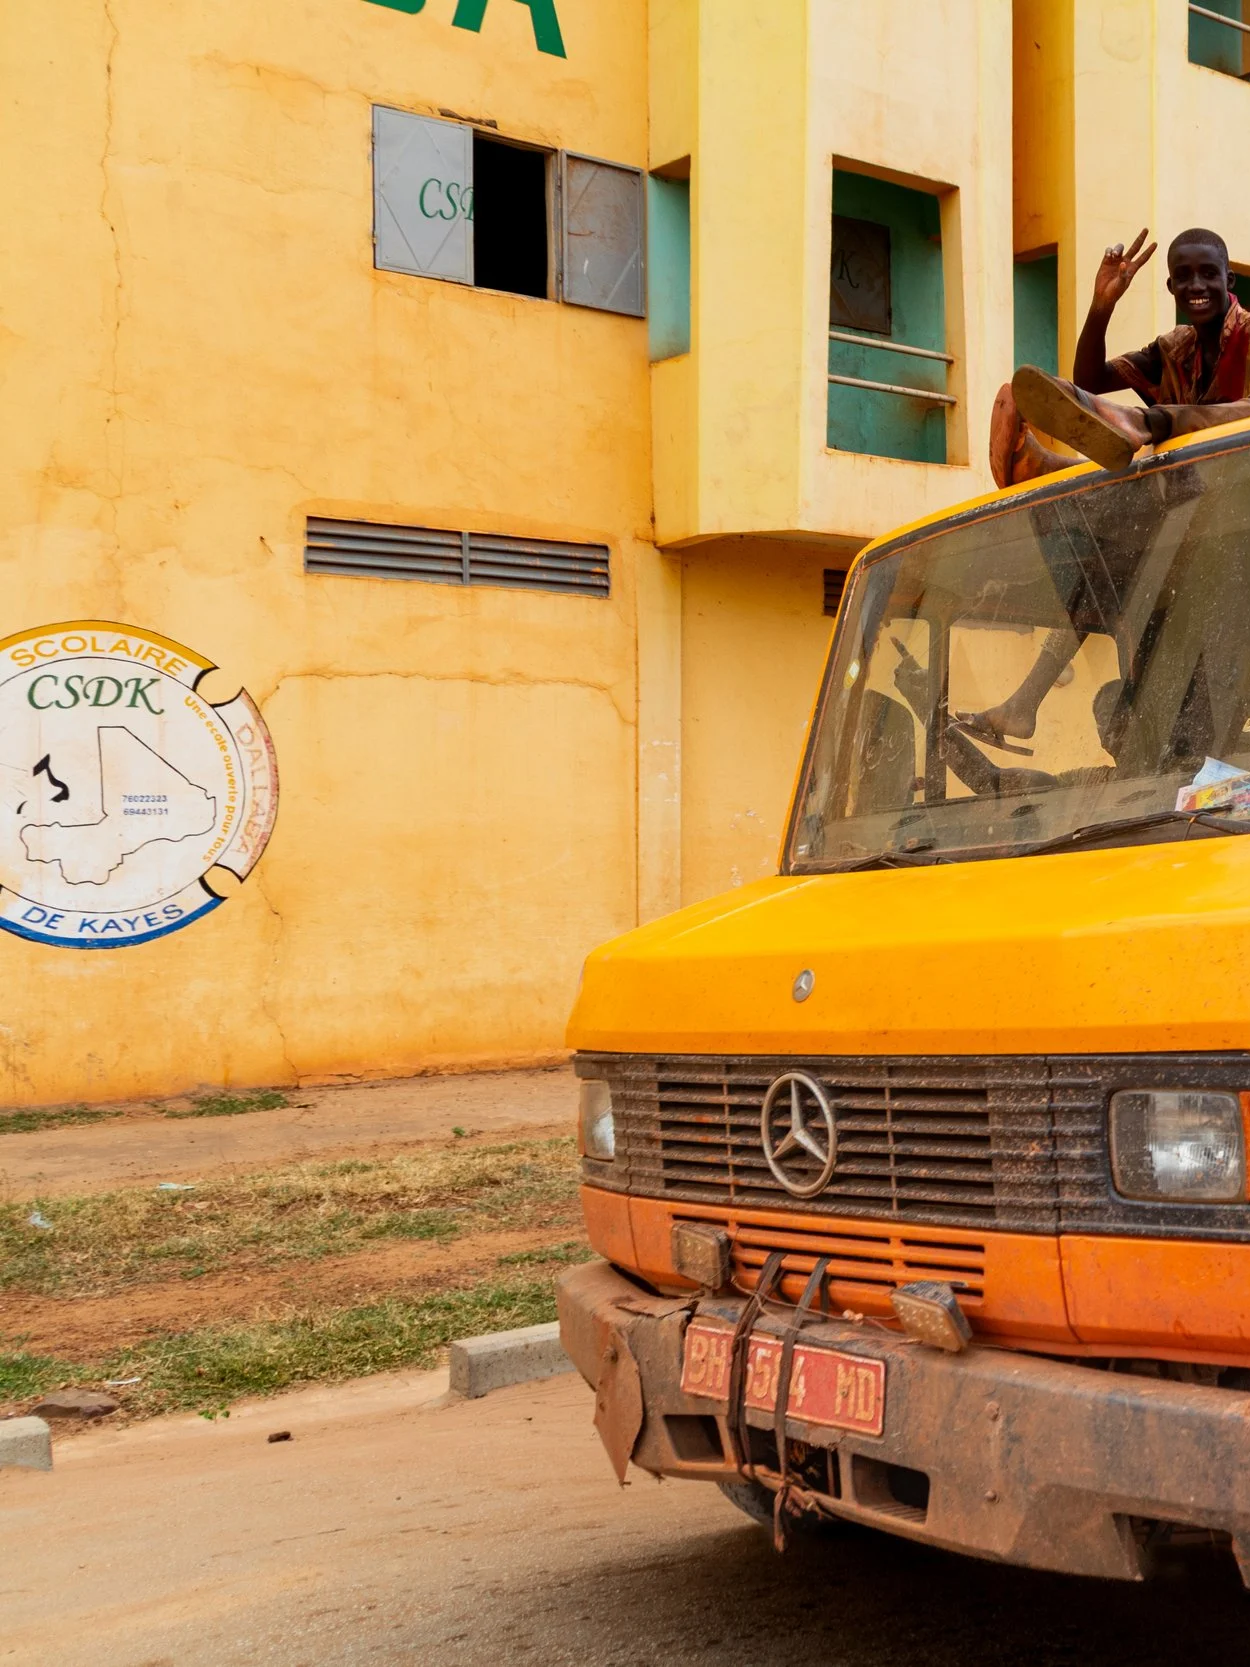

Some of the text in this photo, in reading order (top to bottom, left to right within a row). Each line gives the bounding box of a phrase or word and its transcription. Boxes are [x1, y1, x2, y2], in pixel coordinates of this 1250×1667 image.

[10, 636, 188, 676] SCOLAIRE
[27, 674, 165, 715] CSDK
[184, 694, 207, 720] Une
[223, 755, 239, 802] ouverte
[221, 804, 236, 834] pour
[203, 837, 225, 862] tous
[21, 904, 184, 933] DE KAYES
[688, 1335, 728, 1389] BH
[834, 1363, 876, 1421] MD
